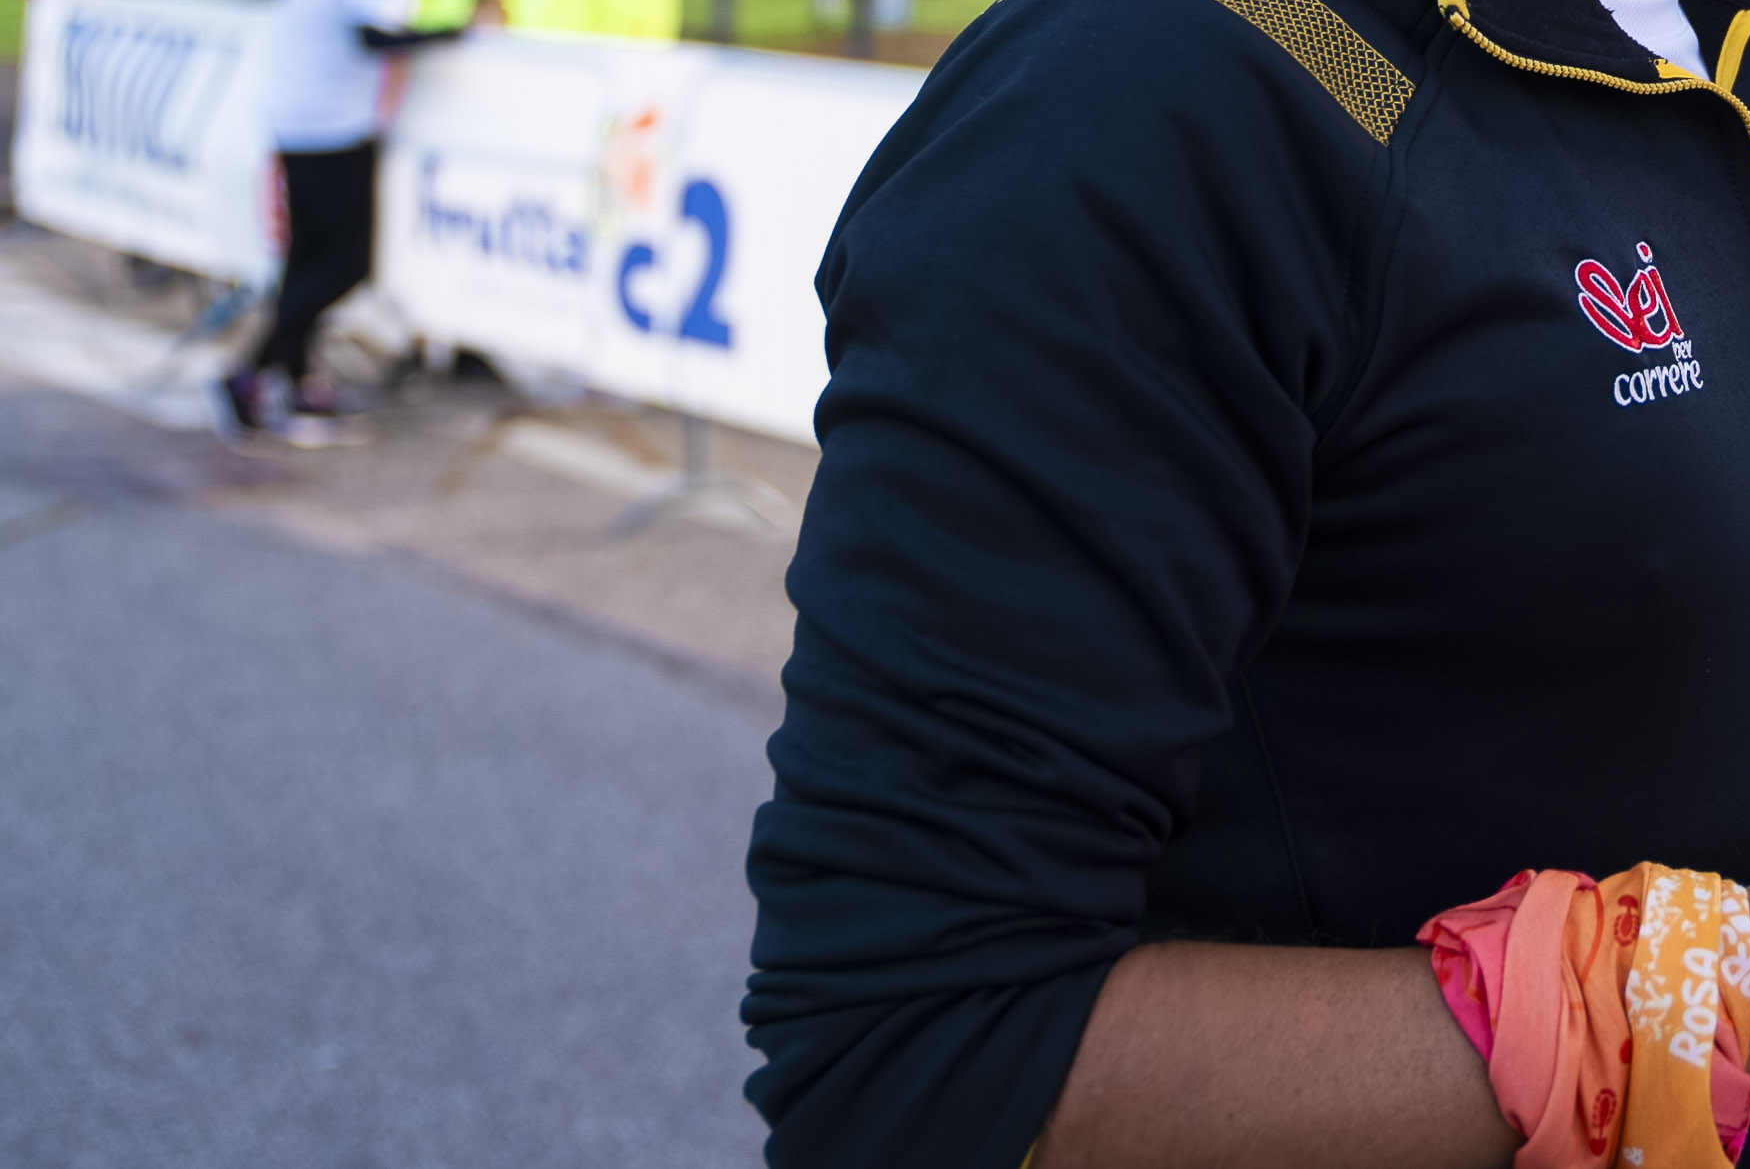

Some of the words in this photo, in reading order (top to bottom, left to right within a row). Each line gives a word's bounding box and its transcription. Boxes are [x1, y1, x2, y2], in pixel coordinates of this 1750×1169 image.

[1574, 241, 1684, 353] Sei
[1613, 358, 1704, 406] correre
[1671, 338, 1693, 362] per
[1669, 947, 1719, 1068] ROSA
